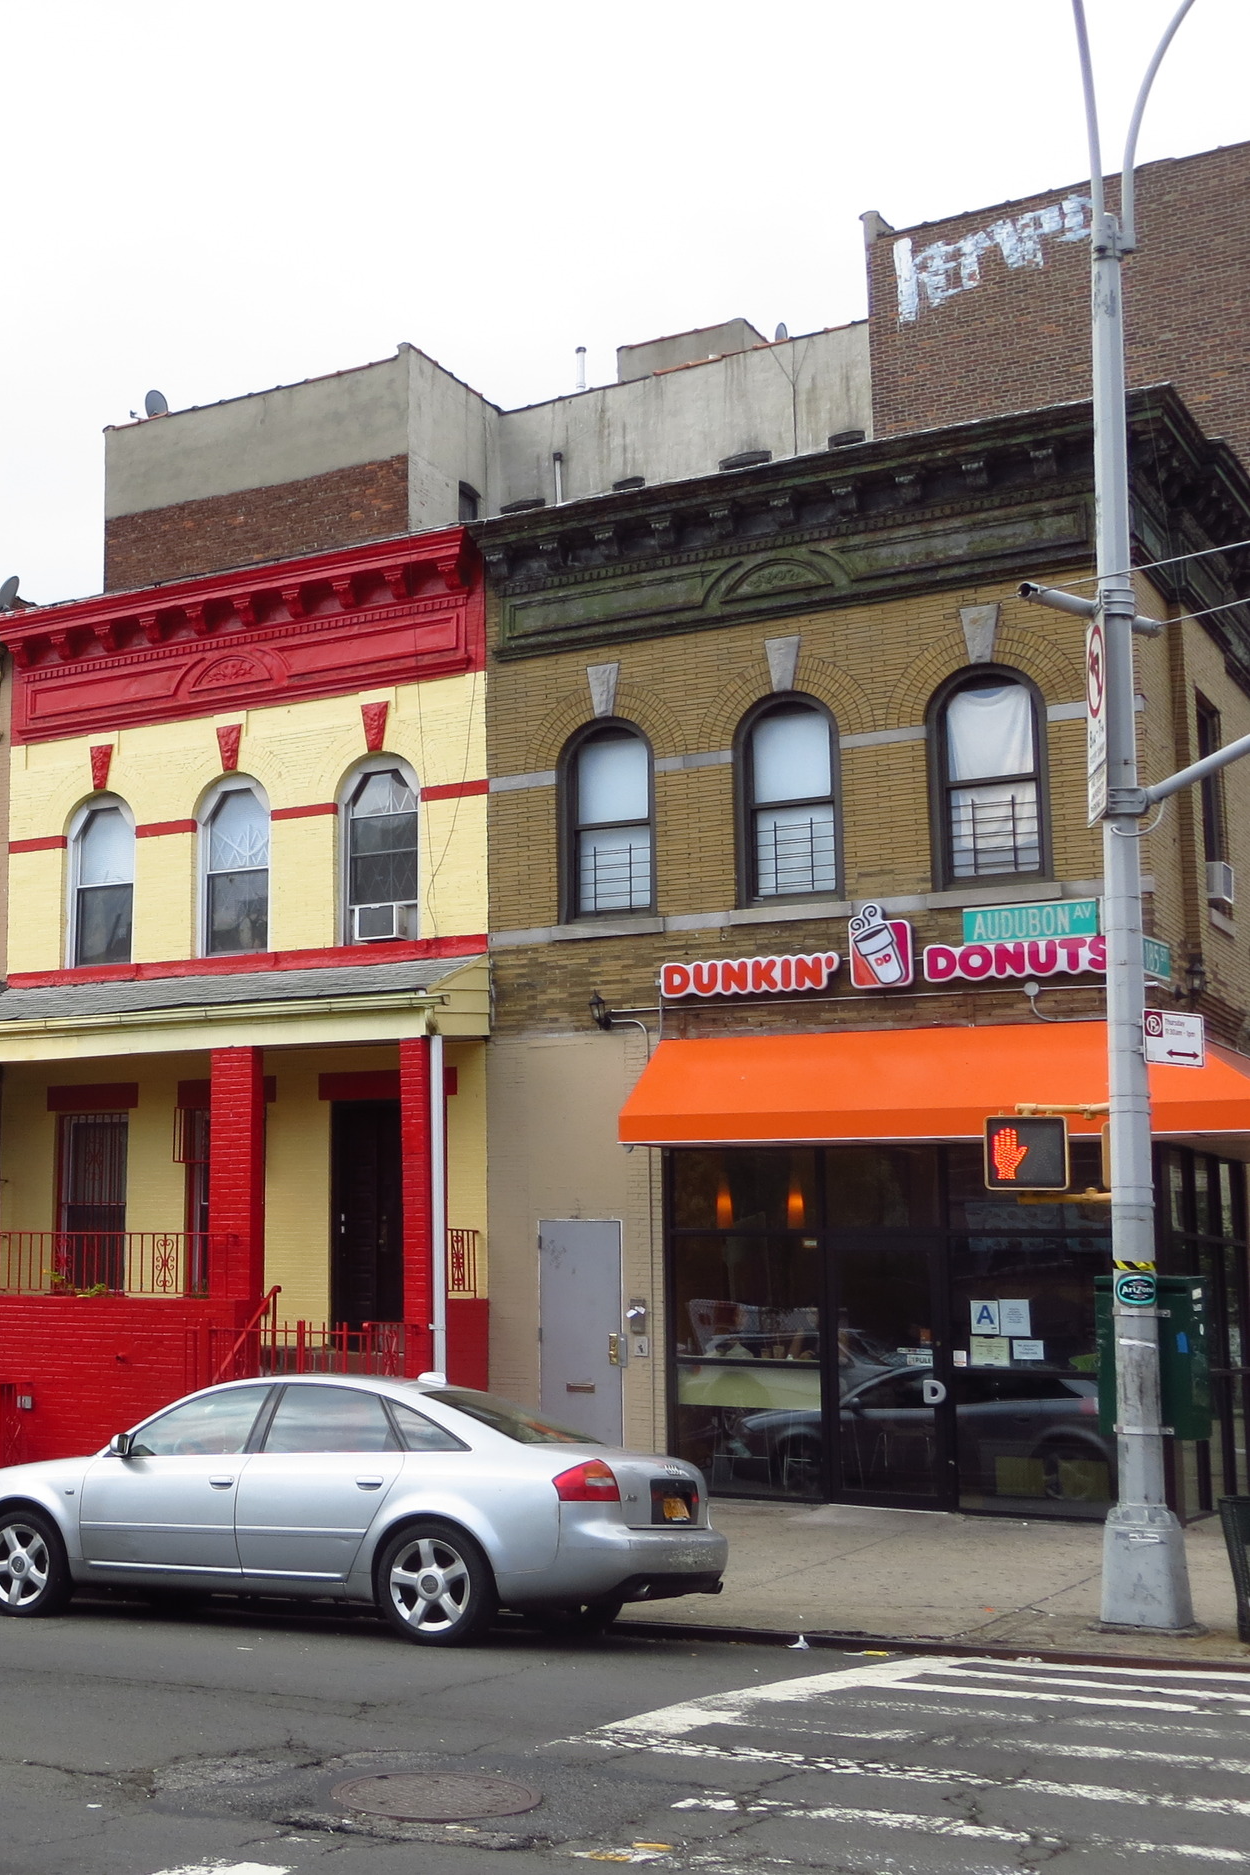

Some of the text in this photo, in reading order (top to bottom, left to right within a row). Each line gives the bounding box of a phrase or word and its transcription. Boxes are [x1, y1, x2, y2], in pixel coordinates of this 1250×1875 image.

[973, 904, 1092, 940] AUDUBON AV
[664, 936, 1106, 995] DUNKIN' DONUTS
[874, 953, 892, 966] DD
[1145, 942, 1159, 972] 185
[1165, 1018, 1185, 1027] Thursday
[976, 1304, 995, 1325] A
